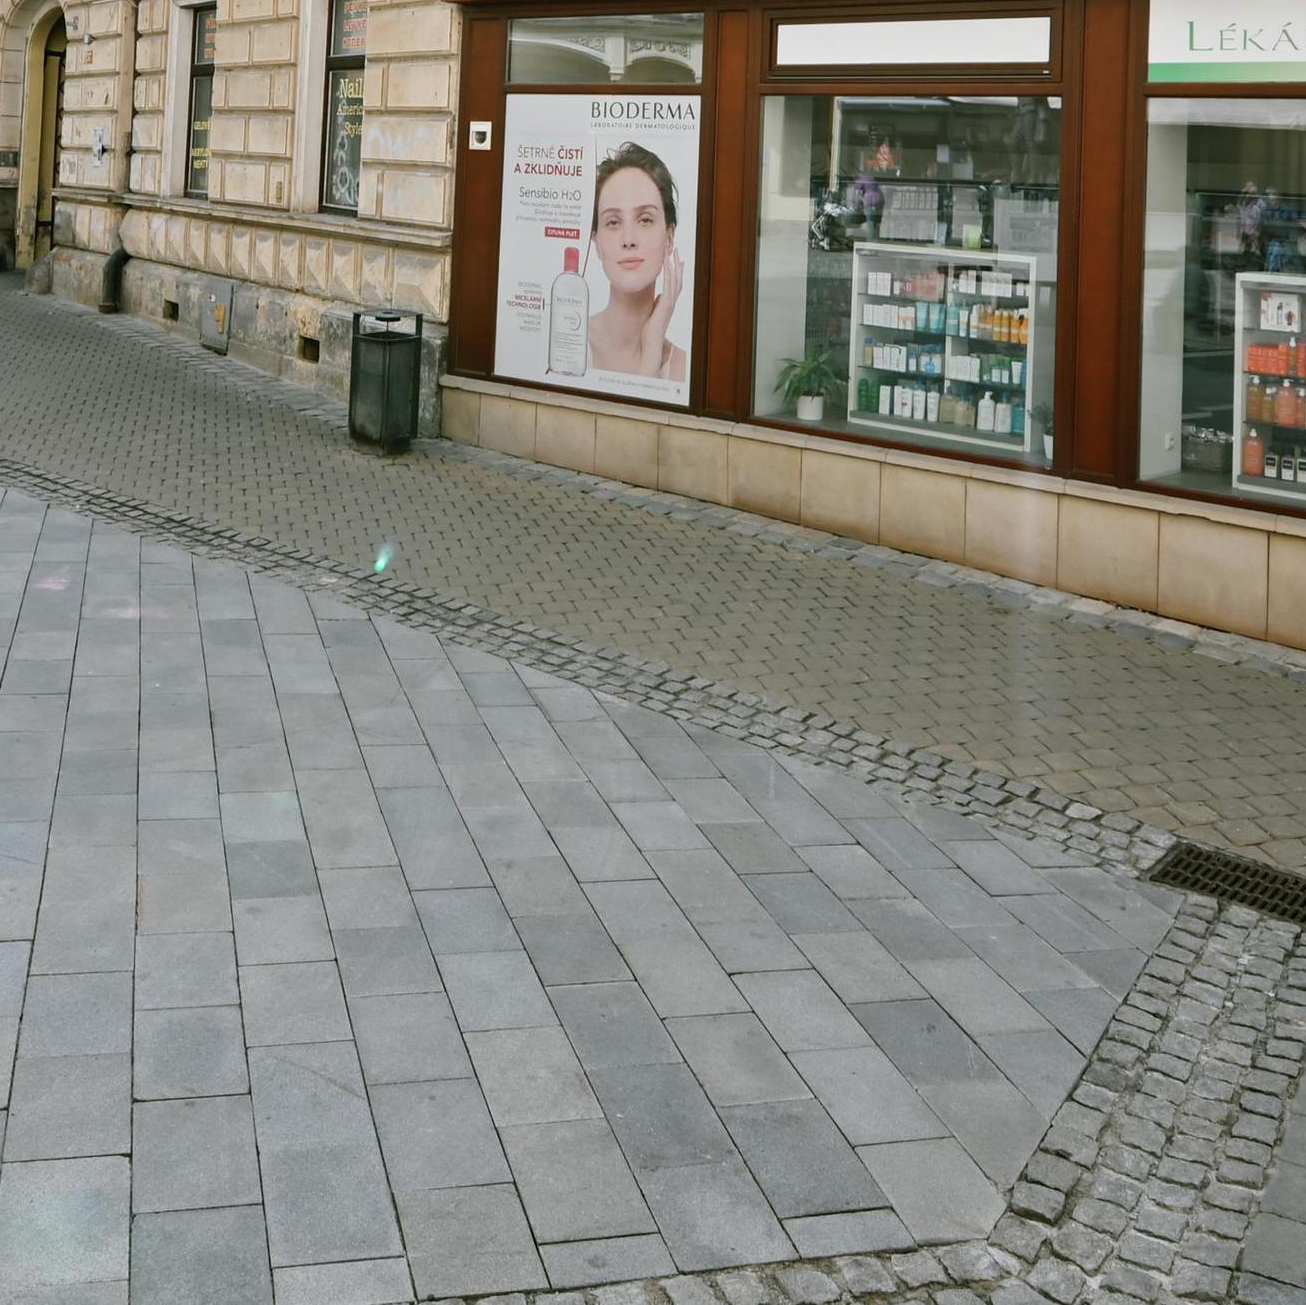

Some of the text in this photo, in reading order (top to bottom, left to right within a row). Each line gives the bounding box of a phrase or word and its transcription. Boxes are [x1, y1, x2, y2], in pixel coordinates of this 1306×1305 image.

[591, 101, 696, 120] BIODERMA
[557, 145, 584, 160] ČISTÍ
[513, 161, 583, 177] A ZKLIDŇUJE
[519, 186, 559, 200] Sensibio
